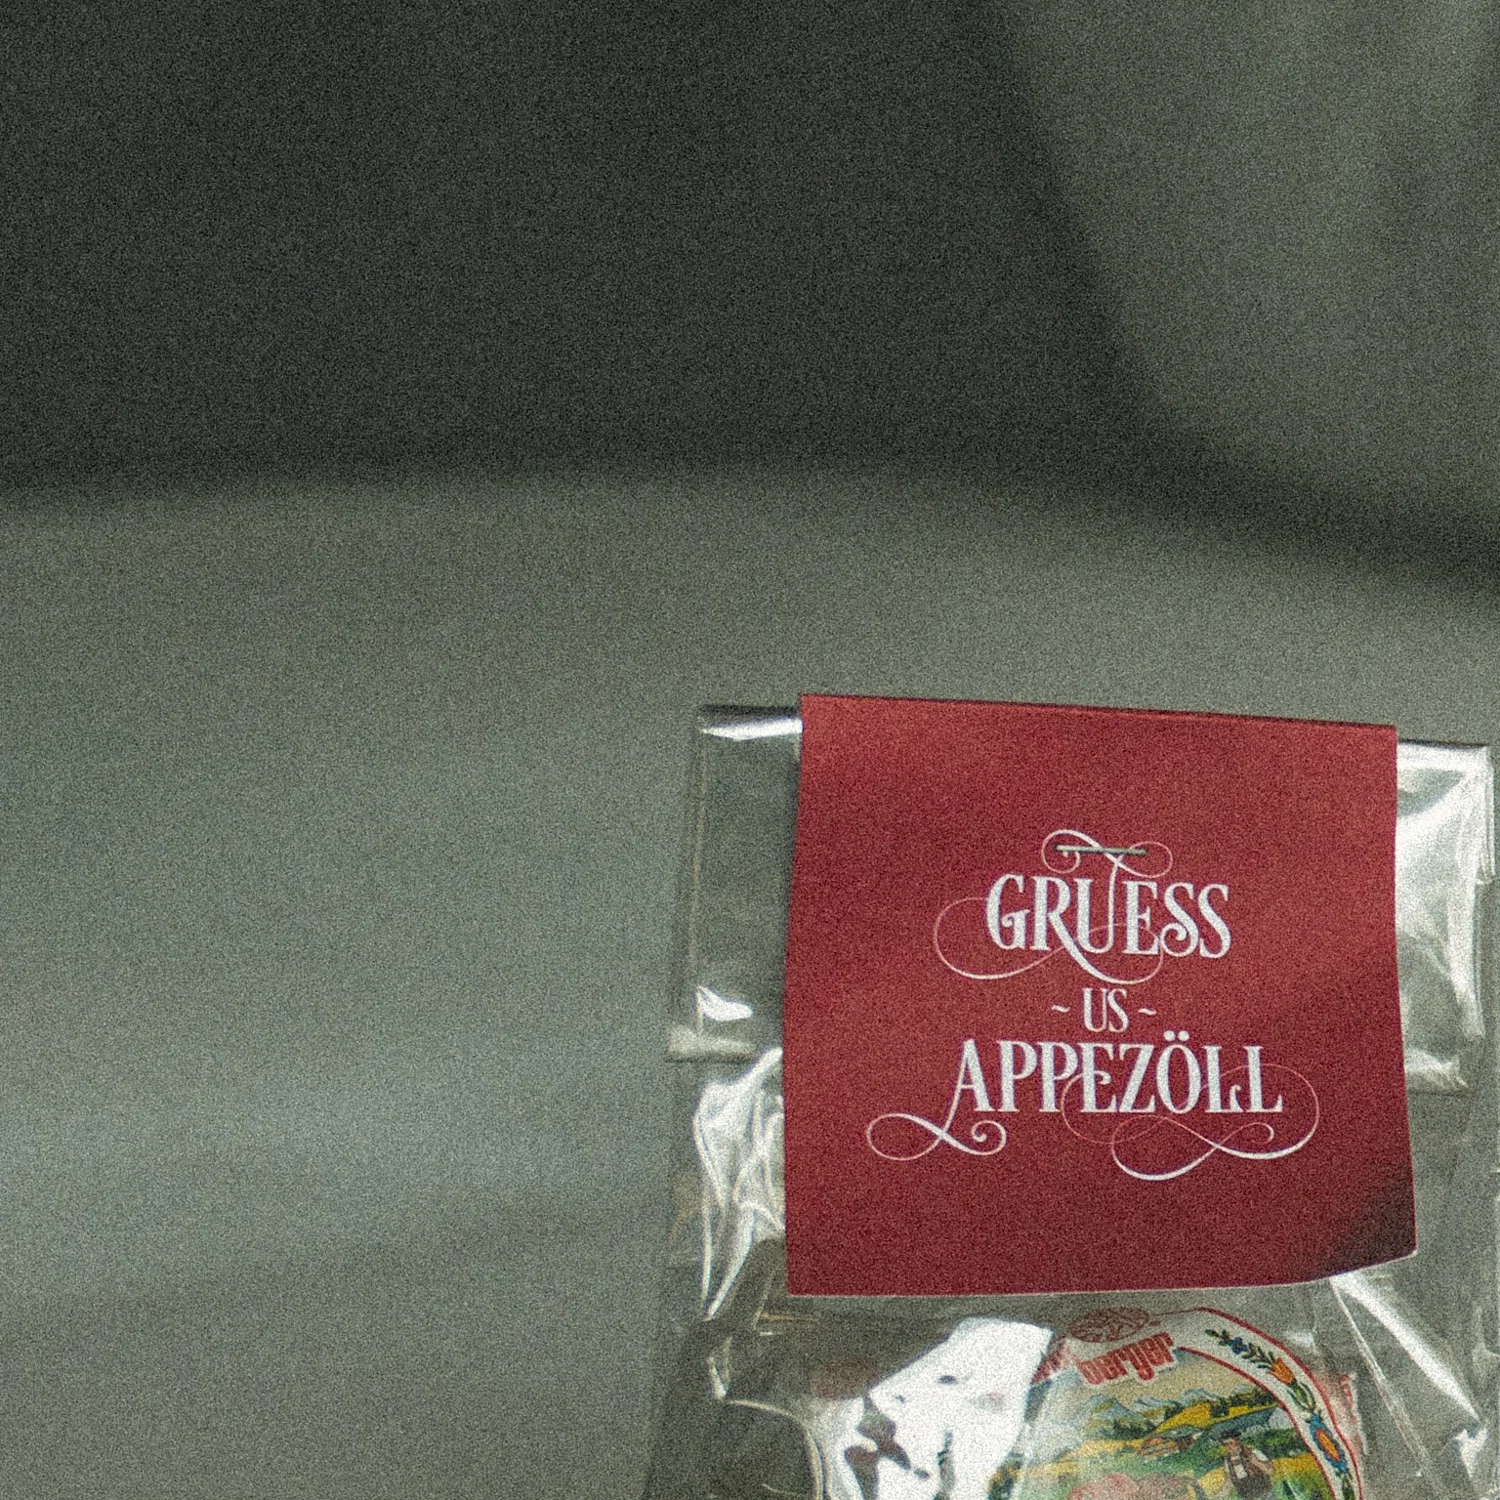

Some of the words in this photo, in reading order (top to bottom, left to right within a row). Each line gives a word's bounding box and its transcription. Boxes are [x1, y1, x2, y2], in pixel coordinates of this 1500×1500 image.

[968, 848, 1233, 974] GRUESS
[1081, 986, 1130, 1033] US
[915, 1030, 1300, 1142] APPEZÖLL
